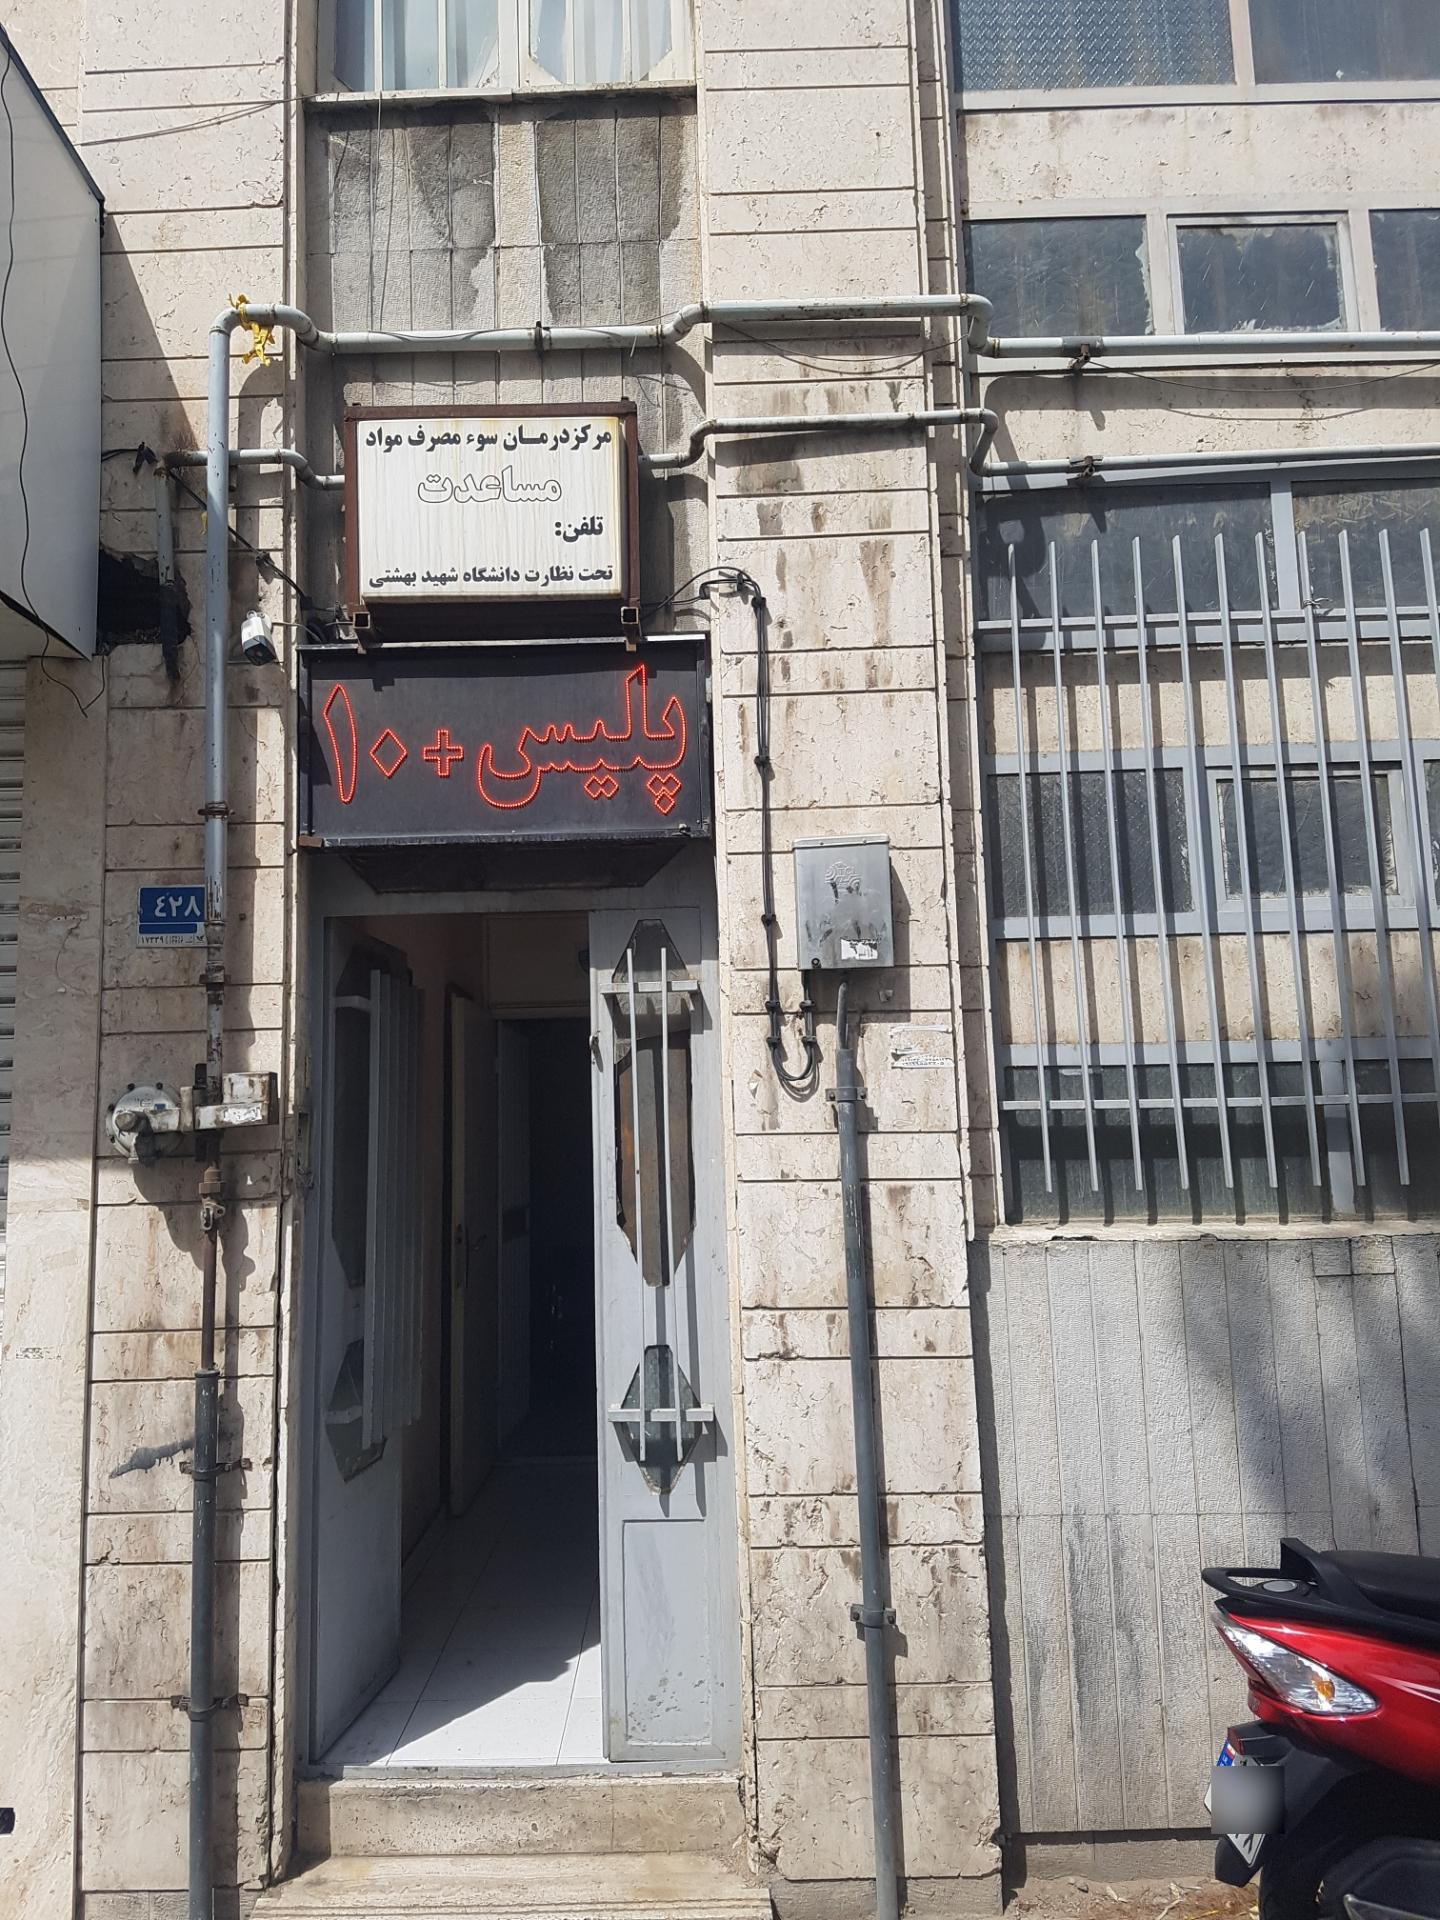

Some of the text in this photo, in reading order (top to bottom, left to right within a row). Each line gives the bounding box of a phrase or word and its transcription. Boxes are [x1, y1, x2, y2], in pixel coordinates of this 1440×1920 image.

[365, 426, 403, 453] مواد
[408, 424, 461, 452] مصرف
[466, 432, 498, 452] سوء
[571, 424, 612, 451] مرکز
[417, 464, 563, 504] مساعدت
[554, 516, 604, 543] تلفن:
[369, 565, 614, 589] تحت نظارت دانشگاه شهید بهشتی
[477, 662, 688, 816] پلیس
